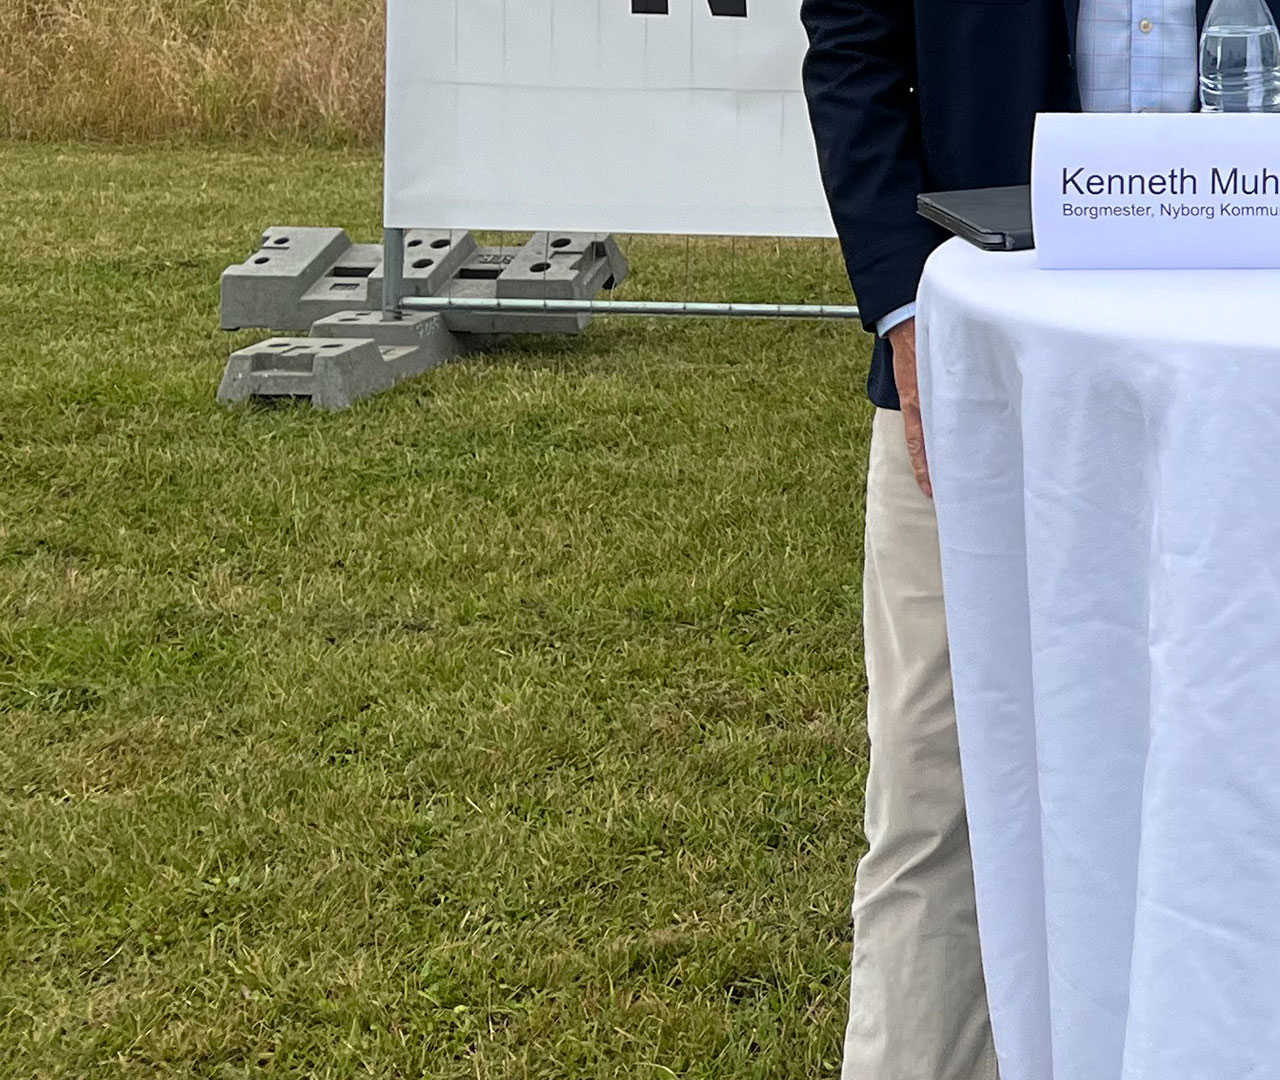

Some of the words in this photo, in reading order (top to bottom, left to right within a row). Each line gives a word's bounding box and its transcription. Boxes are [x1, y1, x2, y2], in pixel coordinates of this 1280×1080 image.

[1062, 167, 1197, 195] Kenneth
[1063, 203, 1154, 219] Borgmester,
[1160, 203, 1215, 219] Nyborg
